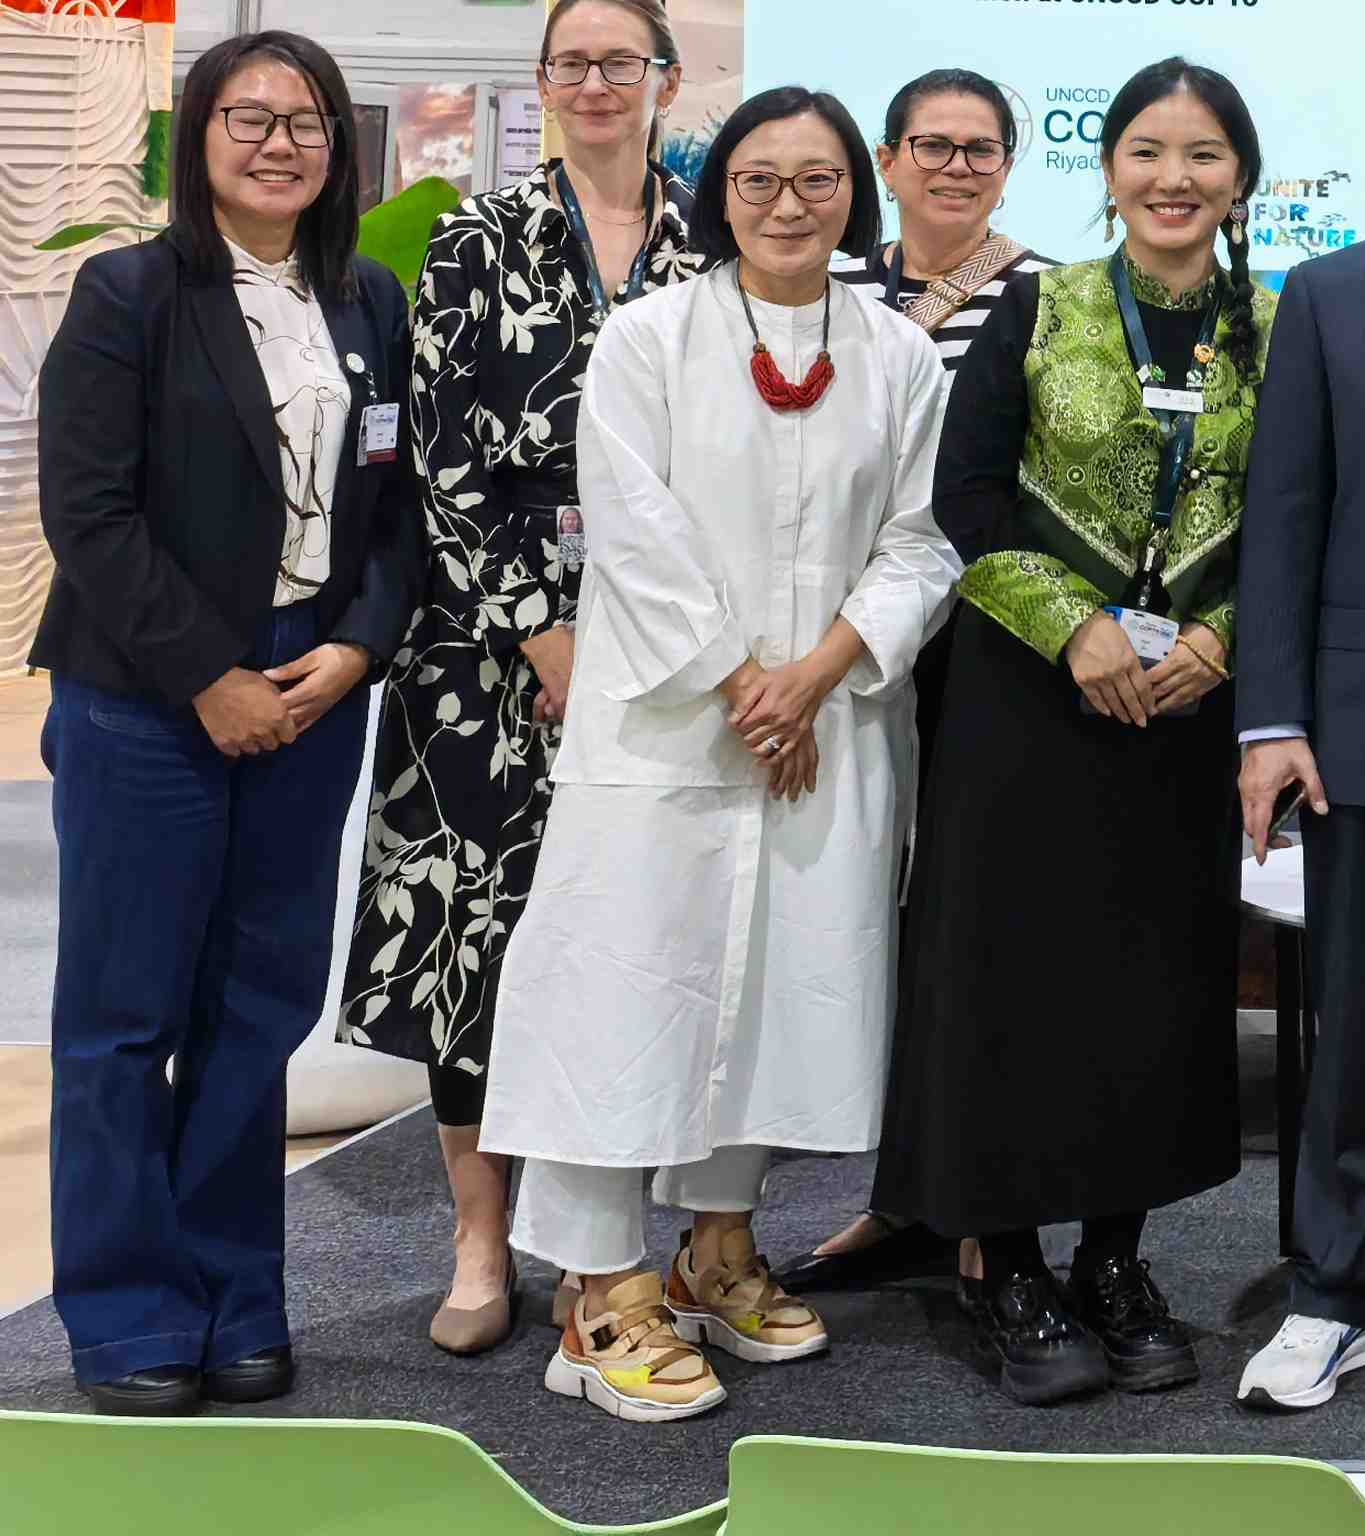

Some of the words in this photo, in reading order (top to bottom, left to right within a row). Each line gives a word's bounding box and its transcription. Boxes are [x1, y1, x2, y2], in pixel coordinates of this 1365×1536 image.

[1046, 87, 1110, 103] UNCCD
[1256, 178, 1329, 198] UNITE
[1254, 203, 1309, 221] FOR
[1253, 226, 1356, 248] NATURE
